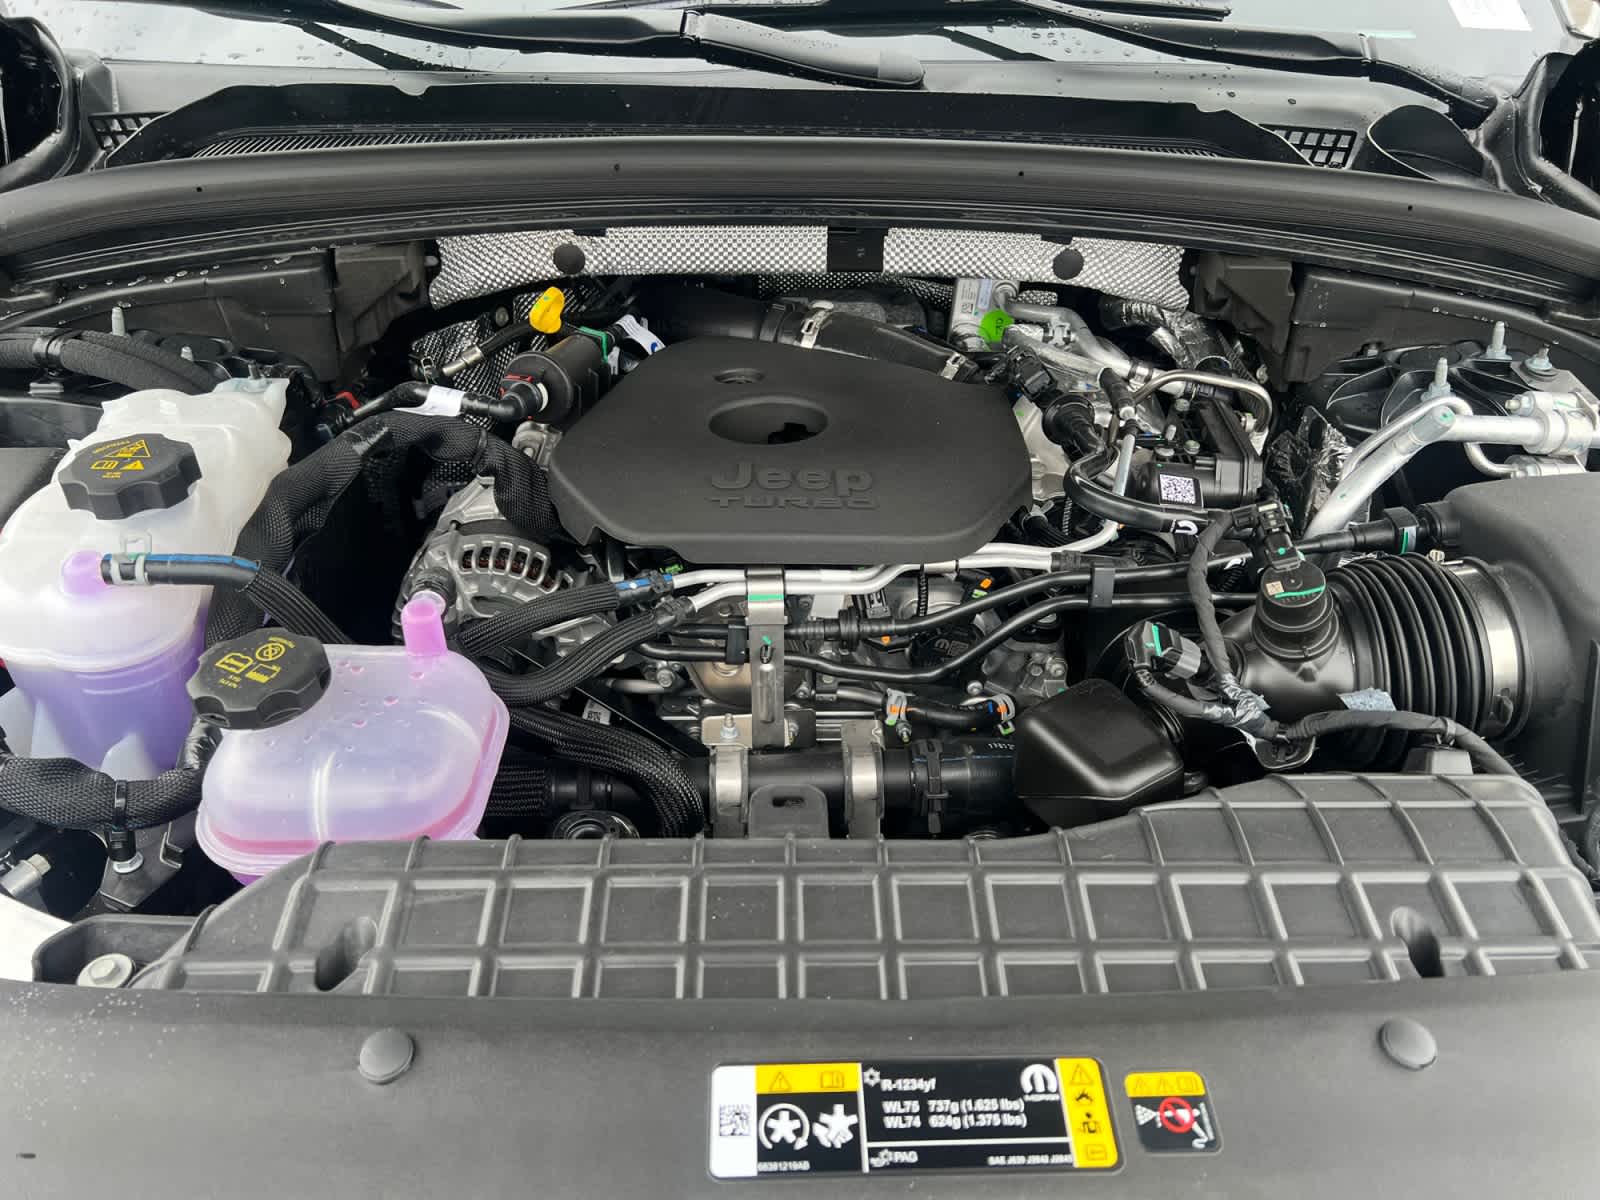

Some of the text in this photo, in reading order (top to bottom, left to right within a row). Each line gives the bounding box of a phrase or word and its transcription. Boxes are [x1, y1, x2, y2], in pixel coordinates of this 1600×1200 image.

[711, 461, 873, 497] Jeep
[705, 496, 879, 510] TURBO
[880, 1077, 937, 1093] R-1234yf
[881, 1100, 920, 1113] WL75
[927, 1099, 960, 1115] 737g
[1000, 1098, 1025, 1112] lbs)
[883, 1115, 922, 1128] WL74
[928, 1114, 961, 1130] 624g
[1001, 1113, 1027, 1128] lbs)
